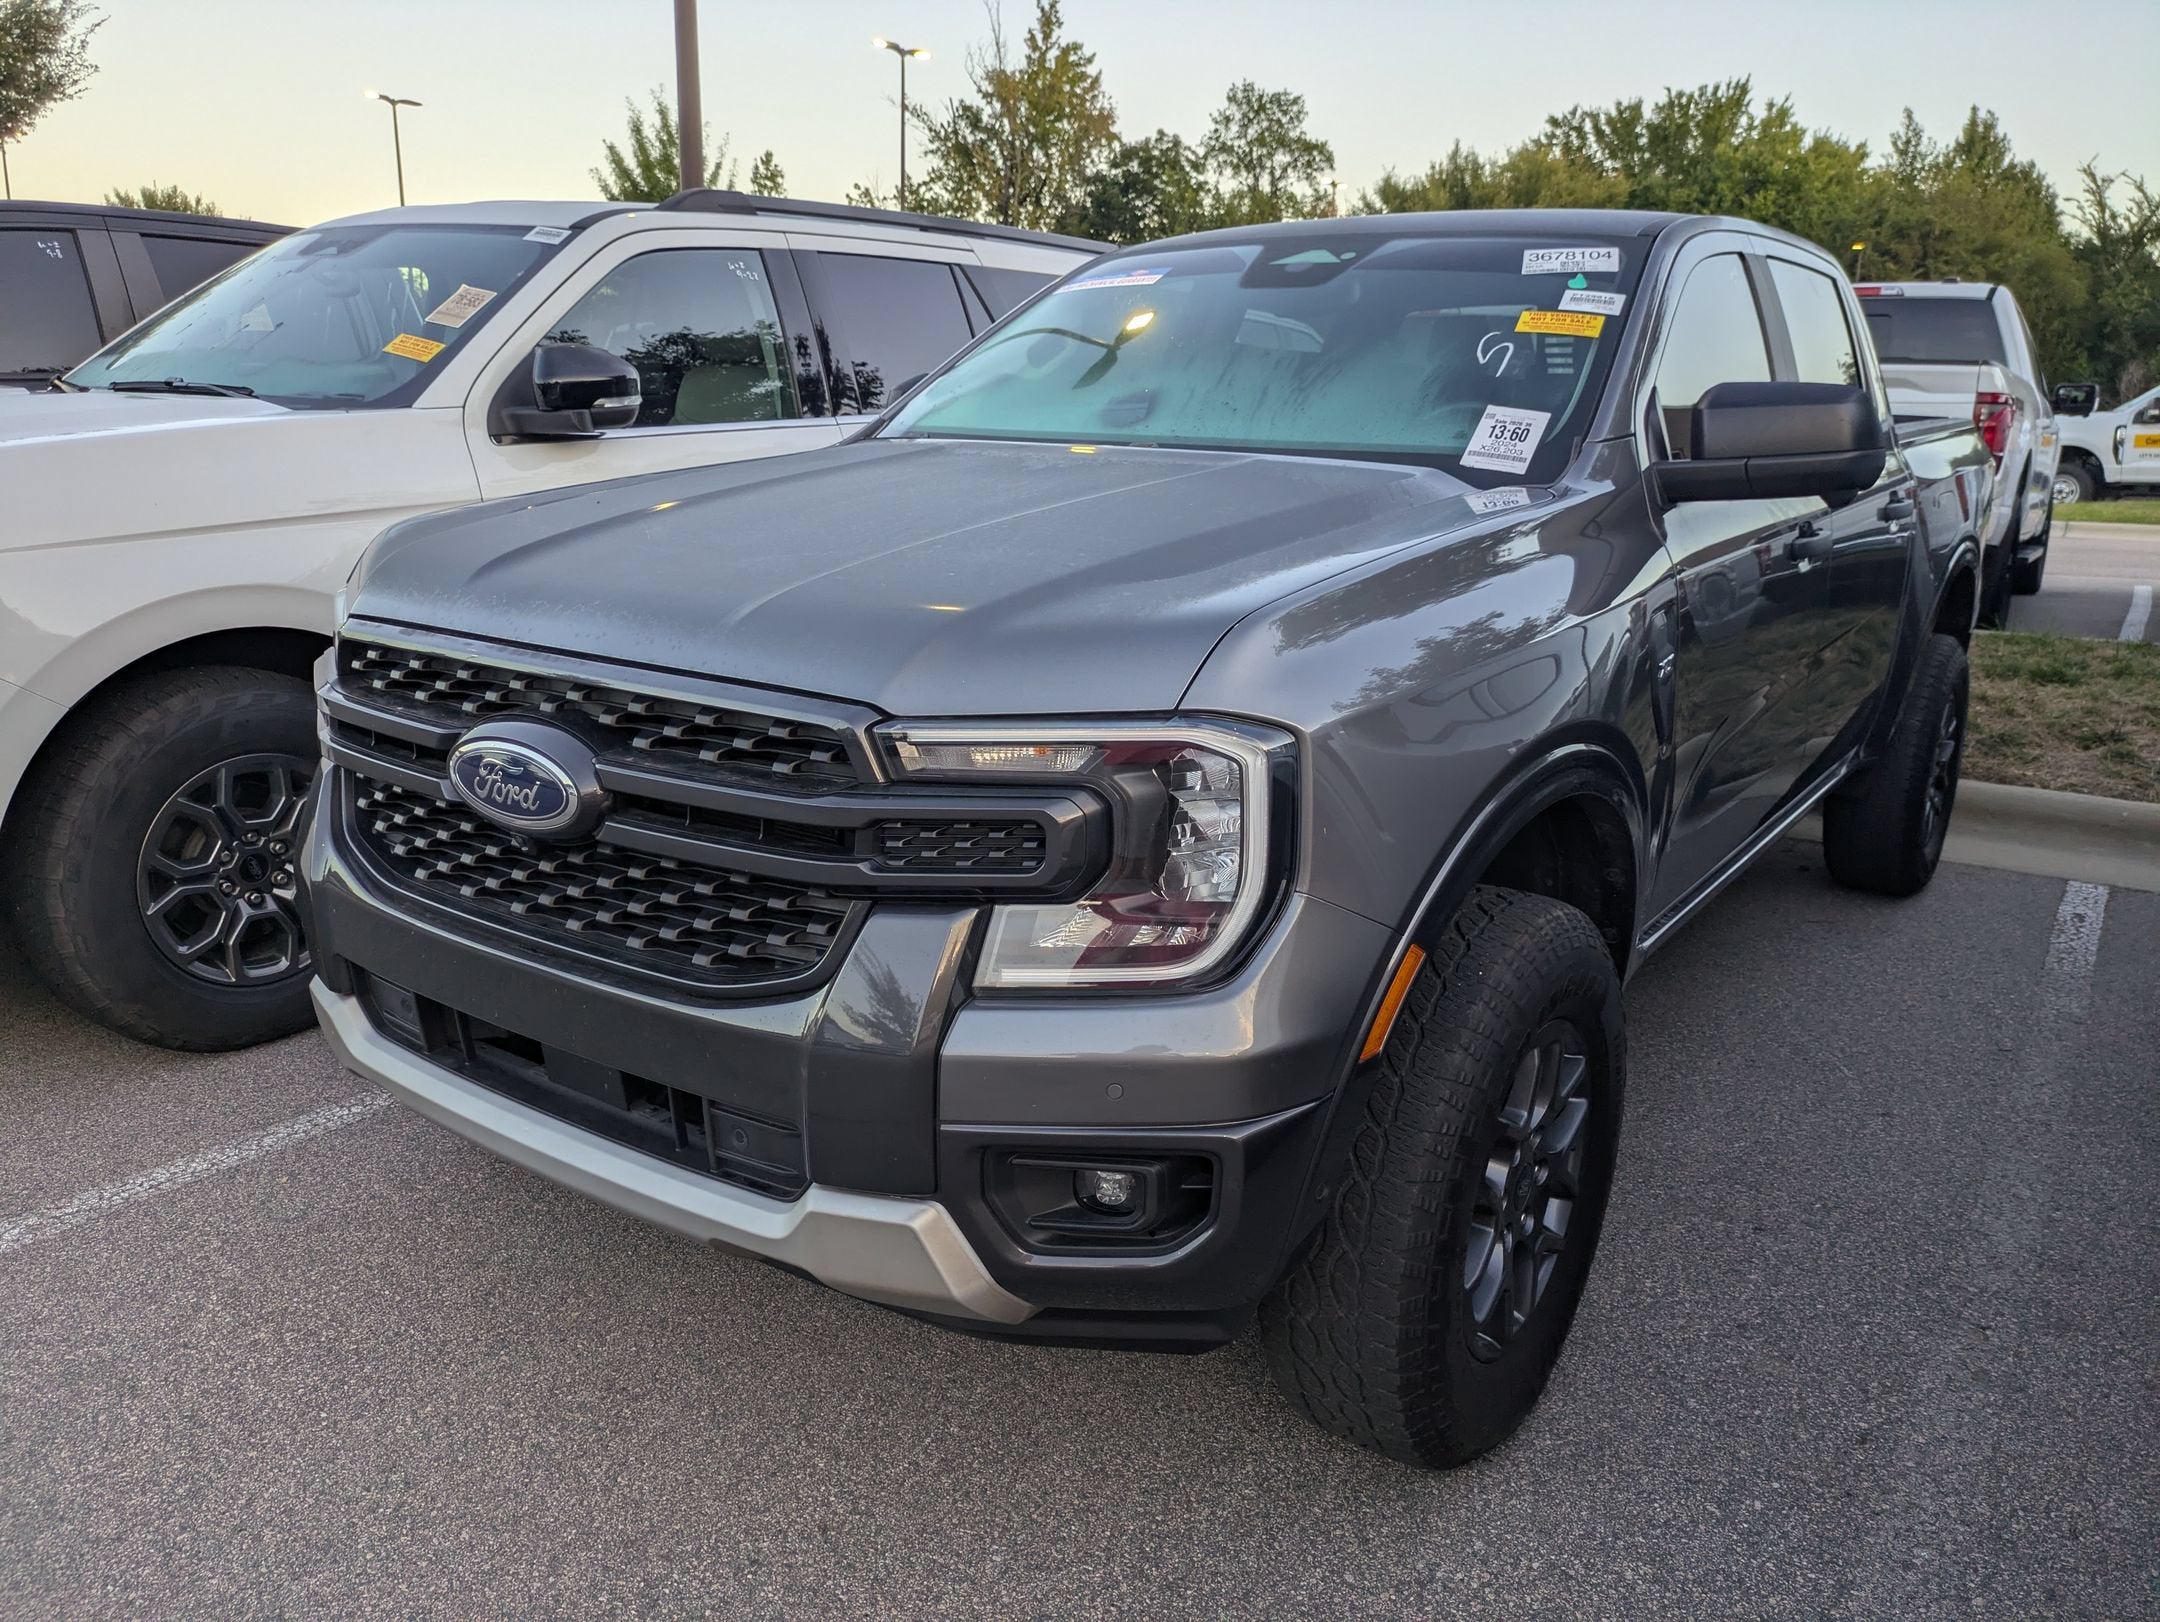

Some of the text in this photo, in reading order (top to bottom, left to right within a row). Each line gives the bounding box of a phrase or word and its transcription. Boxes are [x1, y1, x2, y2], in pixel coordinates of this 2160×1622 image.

[1528, 250, 1613, 263] 3678104
[1488, 424, 1531, 443] 13:60
[1490, 440, 1518, 448] 2024
[474, 758, 541, 811] Ford
